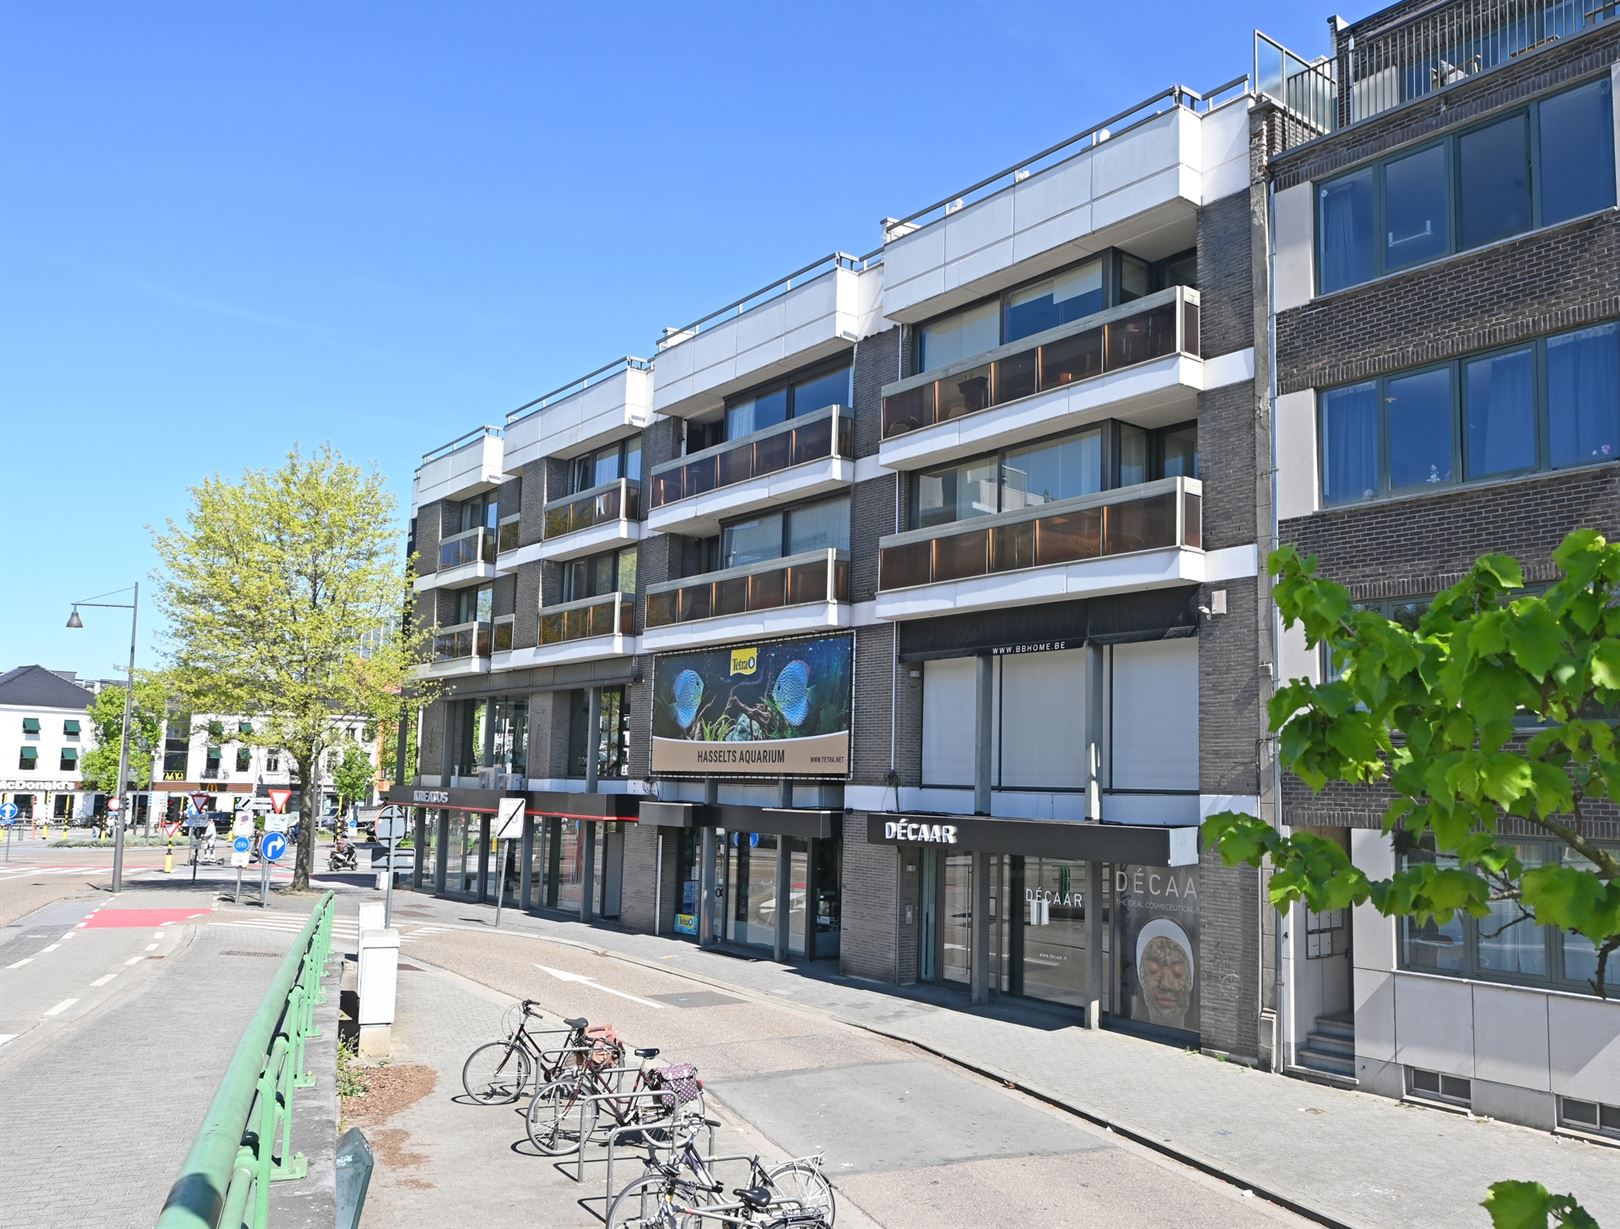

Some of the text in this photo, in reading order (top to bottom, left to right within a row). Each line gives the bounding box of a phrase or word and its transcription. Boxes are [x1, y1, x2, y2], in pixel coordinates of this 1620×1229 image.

[992, 641, 1066, 654] WWW.BBHOME.BE
[732, 658, 748, 671] Tetra
[697, 750, 785, 764] HASSELTS AQUARIUM
[885, 818, 958, 844] DÉCAAR
[1116, 868, 1198, 899] DÉCAA
[1025, 886, 1083, 908] DÉCAAR
